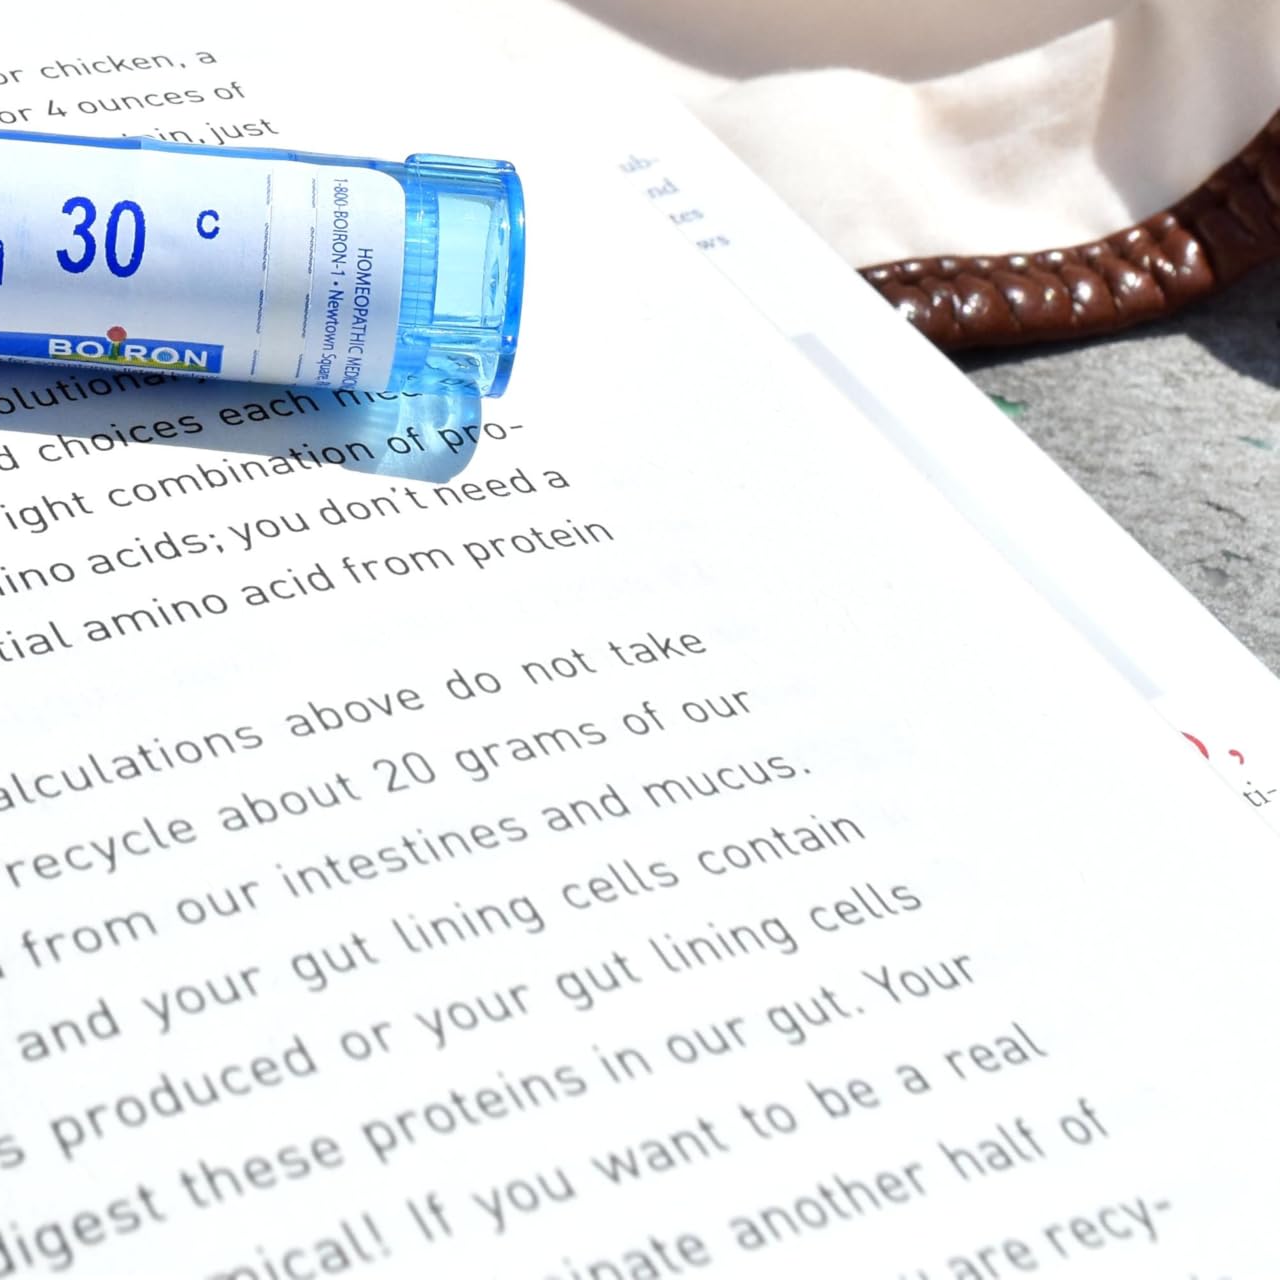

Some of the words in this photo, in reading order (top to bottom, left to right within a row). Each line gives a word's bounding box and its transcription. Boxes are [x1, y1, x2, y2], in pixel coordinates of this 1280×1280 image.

[40, 56, 186, 78] chicken,
[48, 100, 67, 117] 4
[78, 91, 204, 113] ounces
[205, 118, 280, 146] just
[57, 196, 146, 278] 30
[331, 178, 348, 276] 1-800-BOIRON-1
[48, 326, 208, 368] BOIRON
[322, 289, 345, 351] Newtown
[347, 248, 373, 354] HOMEOPATHIC
[39, 416, 203, 462] choices
[219, 384, 319, 427] each
[108, 443, 375, 507] combination
[438, 422, 523, 454] pro-
[88, 532, 224, 574] acids;
[228, 513, 310, 551] you
[433, 468, 536, 505] need
[84, 595, 227, 641] amino
[241, 563, 335, 605] acid
[342, 549, 454, 583] from
[463, 519, 614, 569] protein
[286, 689, 424, 736] above
[522, 649, 597, 684] not
[608, 633, 706, 665] take
[6, 817, 196, 887] recycle
[219, 774, 360, 831] about
[373, 752, 435, 792] 20
[456, 723, 607, 782] grams
[682, 692, 749, 722] our
[22, 912, 157, 967] from
[276, 818, 528, 897] intestines
[542, 784, 630, 831] and
[643, 757, 810, 807] mucus.
[17, 999, 120, 1062] and
[142, 968, 259, 1034] your
[291, 934, 378, 992] gut
[392, 897, 545, 952] lining
[562, 860, 679, 909] cells
[698, 815, 865, 875] contain
[50, 1035, 317, 1160] produced
[415, 985, 530, 1049] your
[556, 953, 641, 1011] gut
[648, 918, 798, 972] lining
[810, 883, 922, 931] cells
[180, 1138, 343, 1208] these
[362, 1066, 587, 1164] proteins
[767, 987, 864, 1045] gut.
[862, 956, 973, 1002] Your
[472, 1169, 576, 1234] you
[592, 1118, 728, 1184] want
[944, 1022, 1047, 1079] real
[730, 1163, 925, 1250] another
[939, 1118, 1044, 1180] half
[1044, 1199, 1170, 1257] recy-
